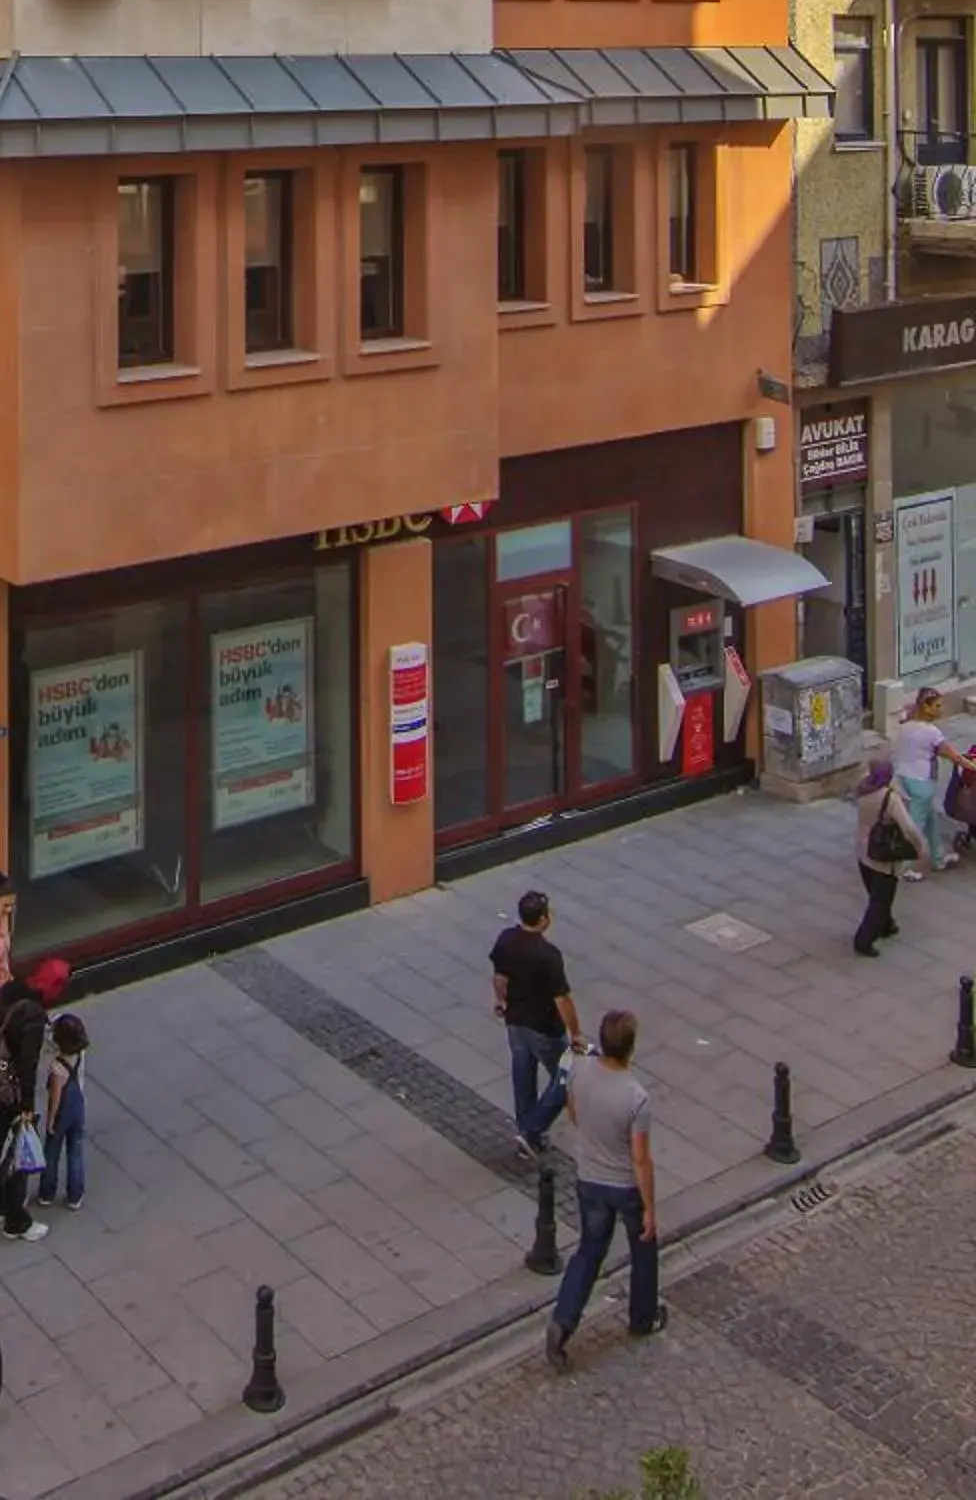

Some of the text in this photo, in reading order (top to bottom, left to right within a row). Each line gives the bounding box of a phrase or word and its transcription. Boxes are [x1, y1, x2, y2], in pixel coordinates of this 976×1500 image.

[802, 414, 865, 443] AVUKAT
[219, 660, 273, 687] büyük
[38, 698, 98, 728] büyük
